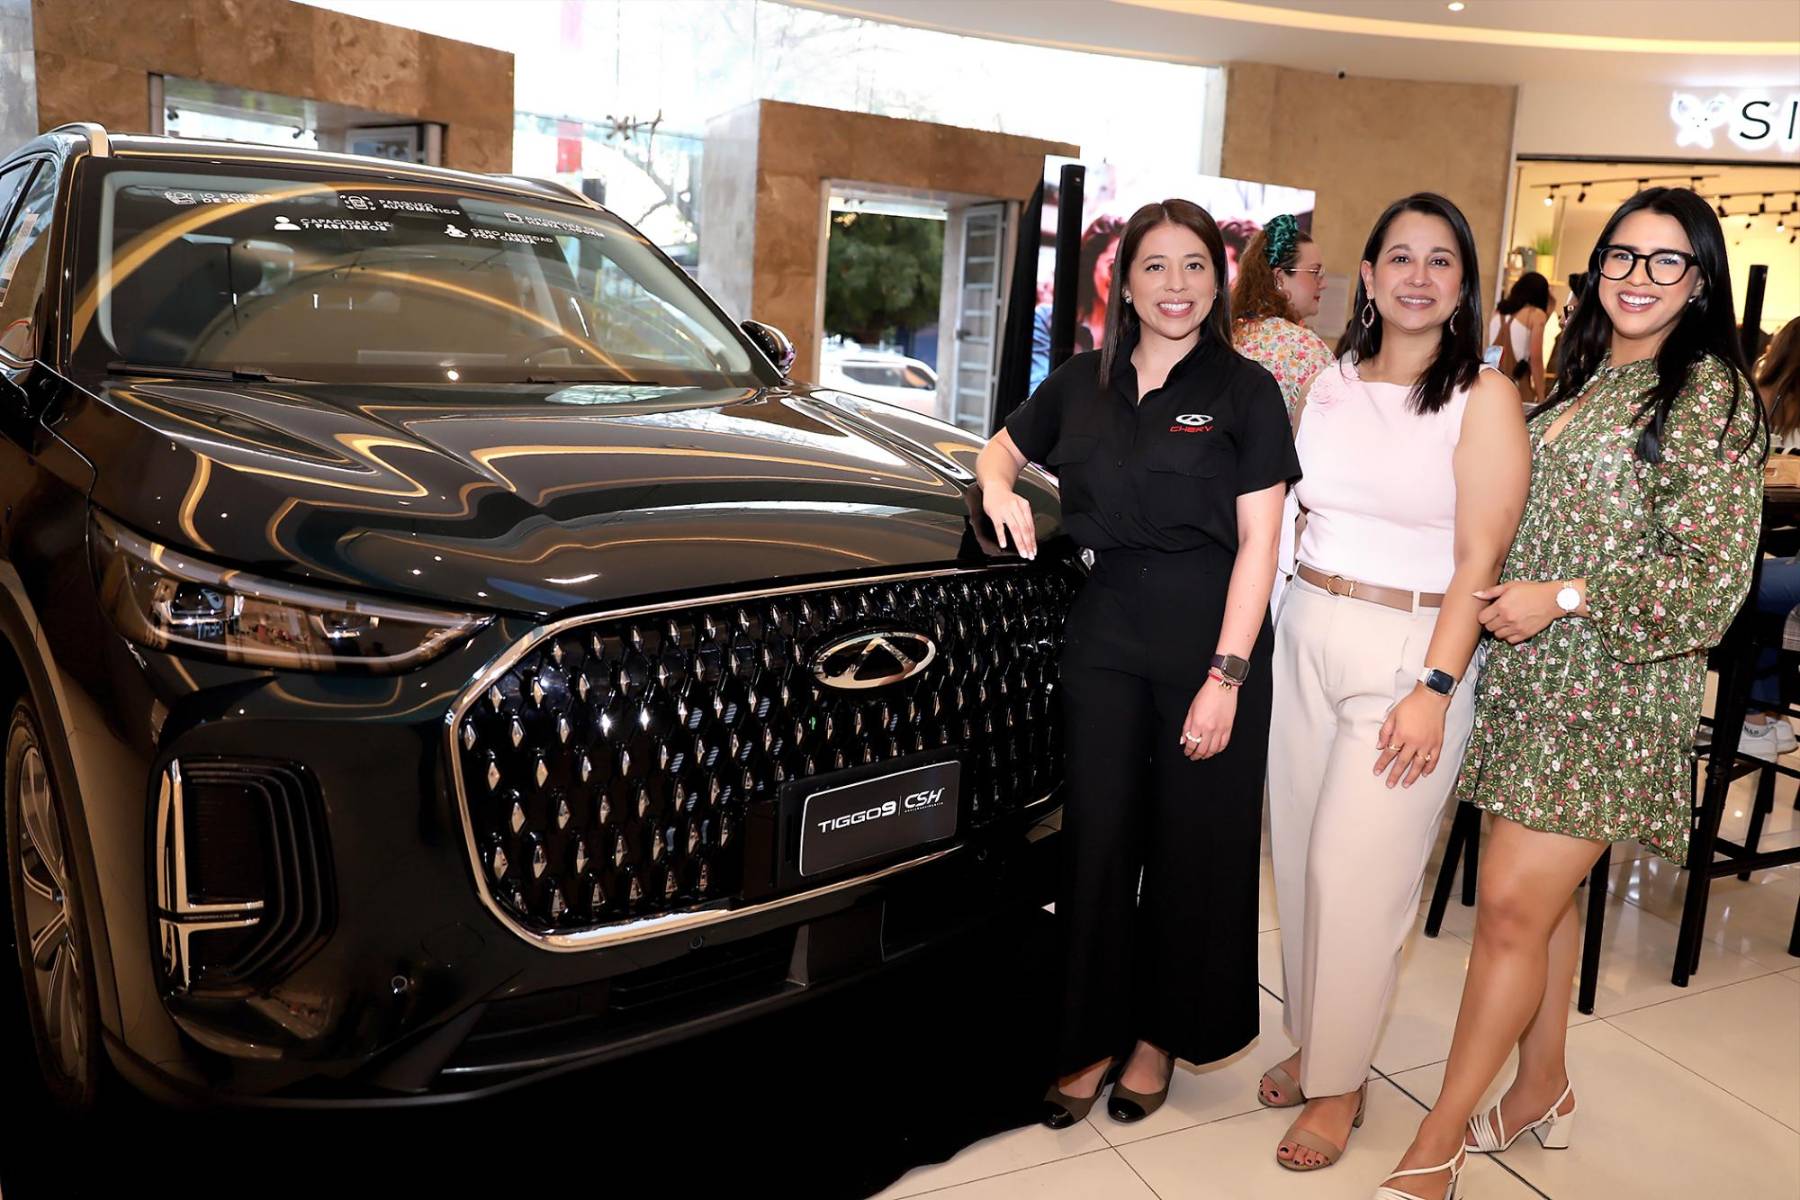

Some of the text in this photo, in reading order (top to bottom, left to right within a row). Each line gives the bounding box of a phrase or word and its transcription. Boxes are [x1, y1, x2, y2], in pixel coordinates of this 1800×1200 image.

[300, 218, 392, 228] CAPACIDAD DE
[315, 223, 388, 231] PASAJEROS
[470, 228, 500, 236] CERO
[473, 232, 497, 240] POR
[904, 787, 946, 809] CSH
